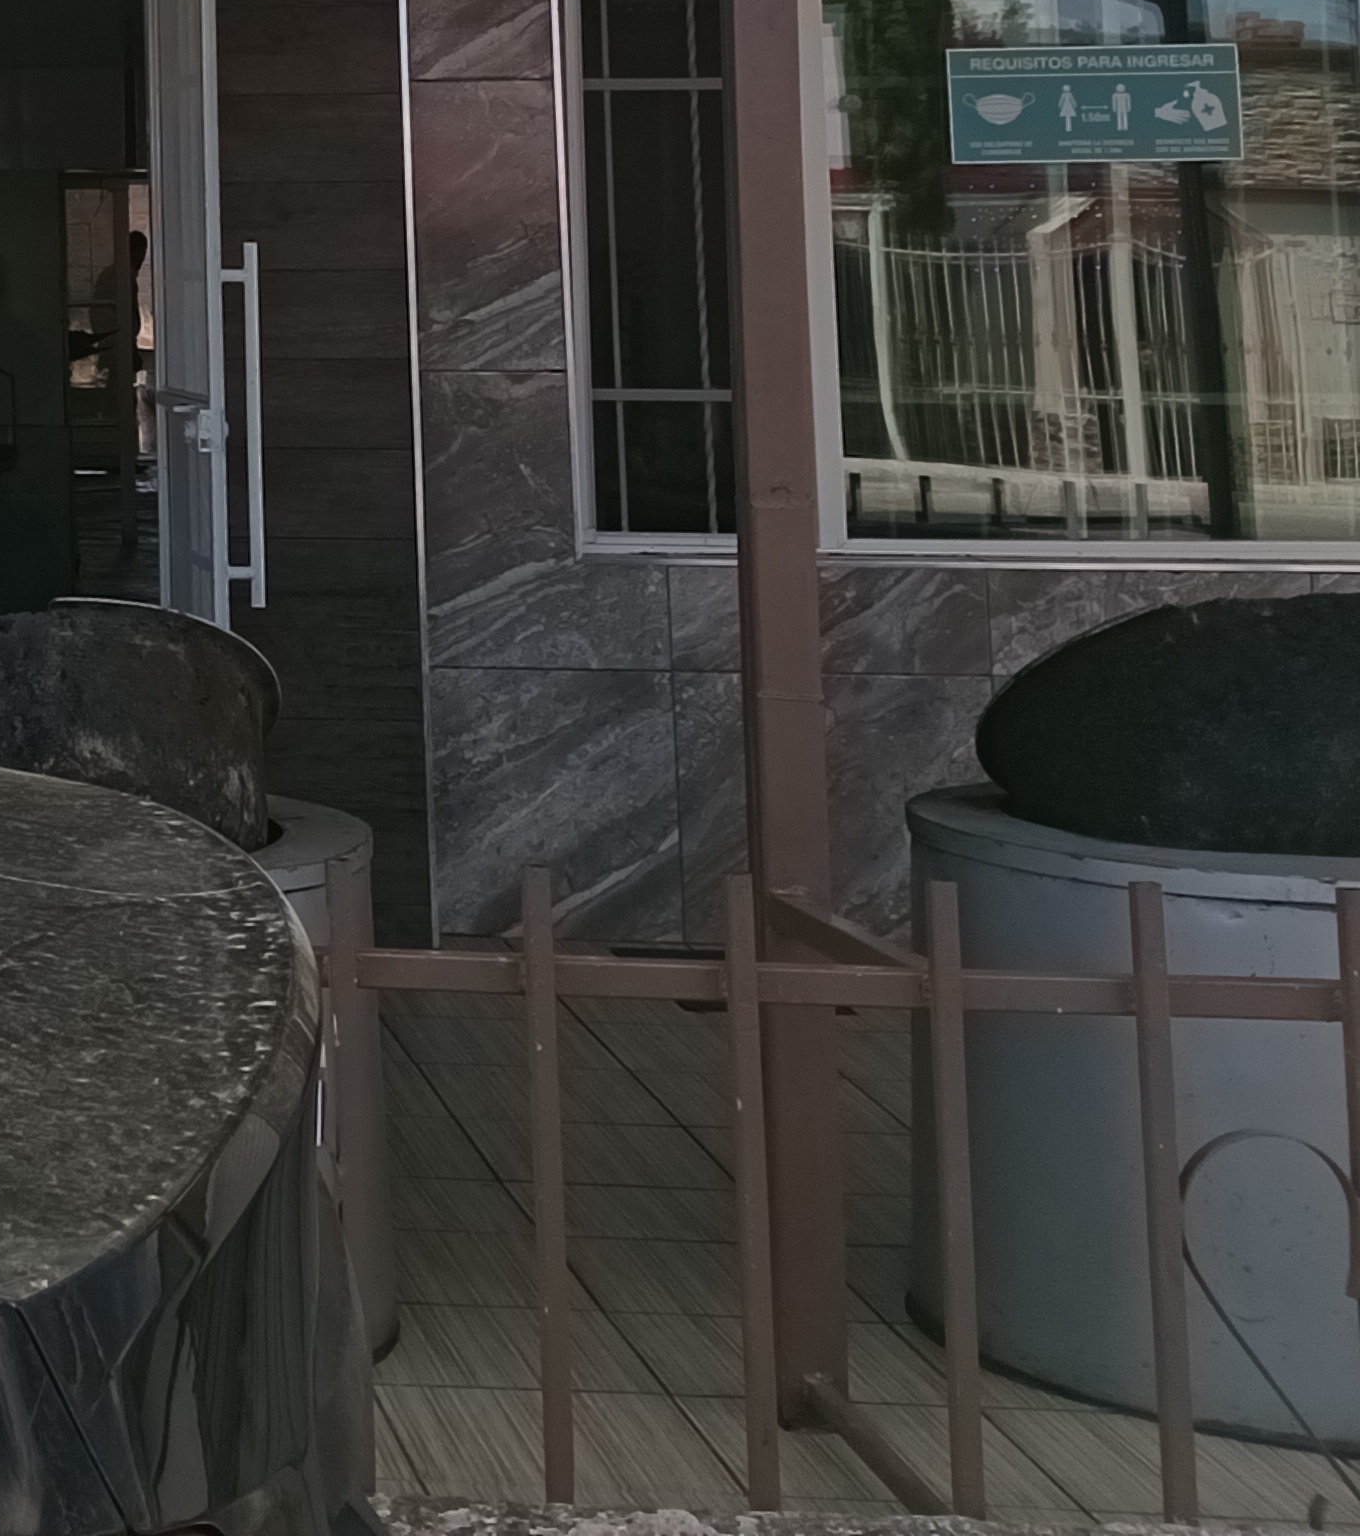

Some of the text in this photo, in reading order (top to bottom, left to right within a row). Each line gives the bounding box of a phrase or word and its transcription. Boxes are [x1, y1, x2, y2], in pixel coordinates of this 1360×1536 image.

[970, 53, 1215, 71] REQUISITOS PARA INGRESAR
